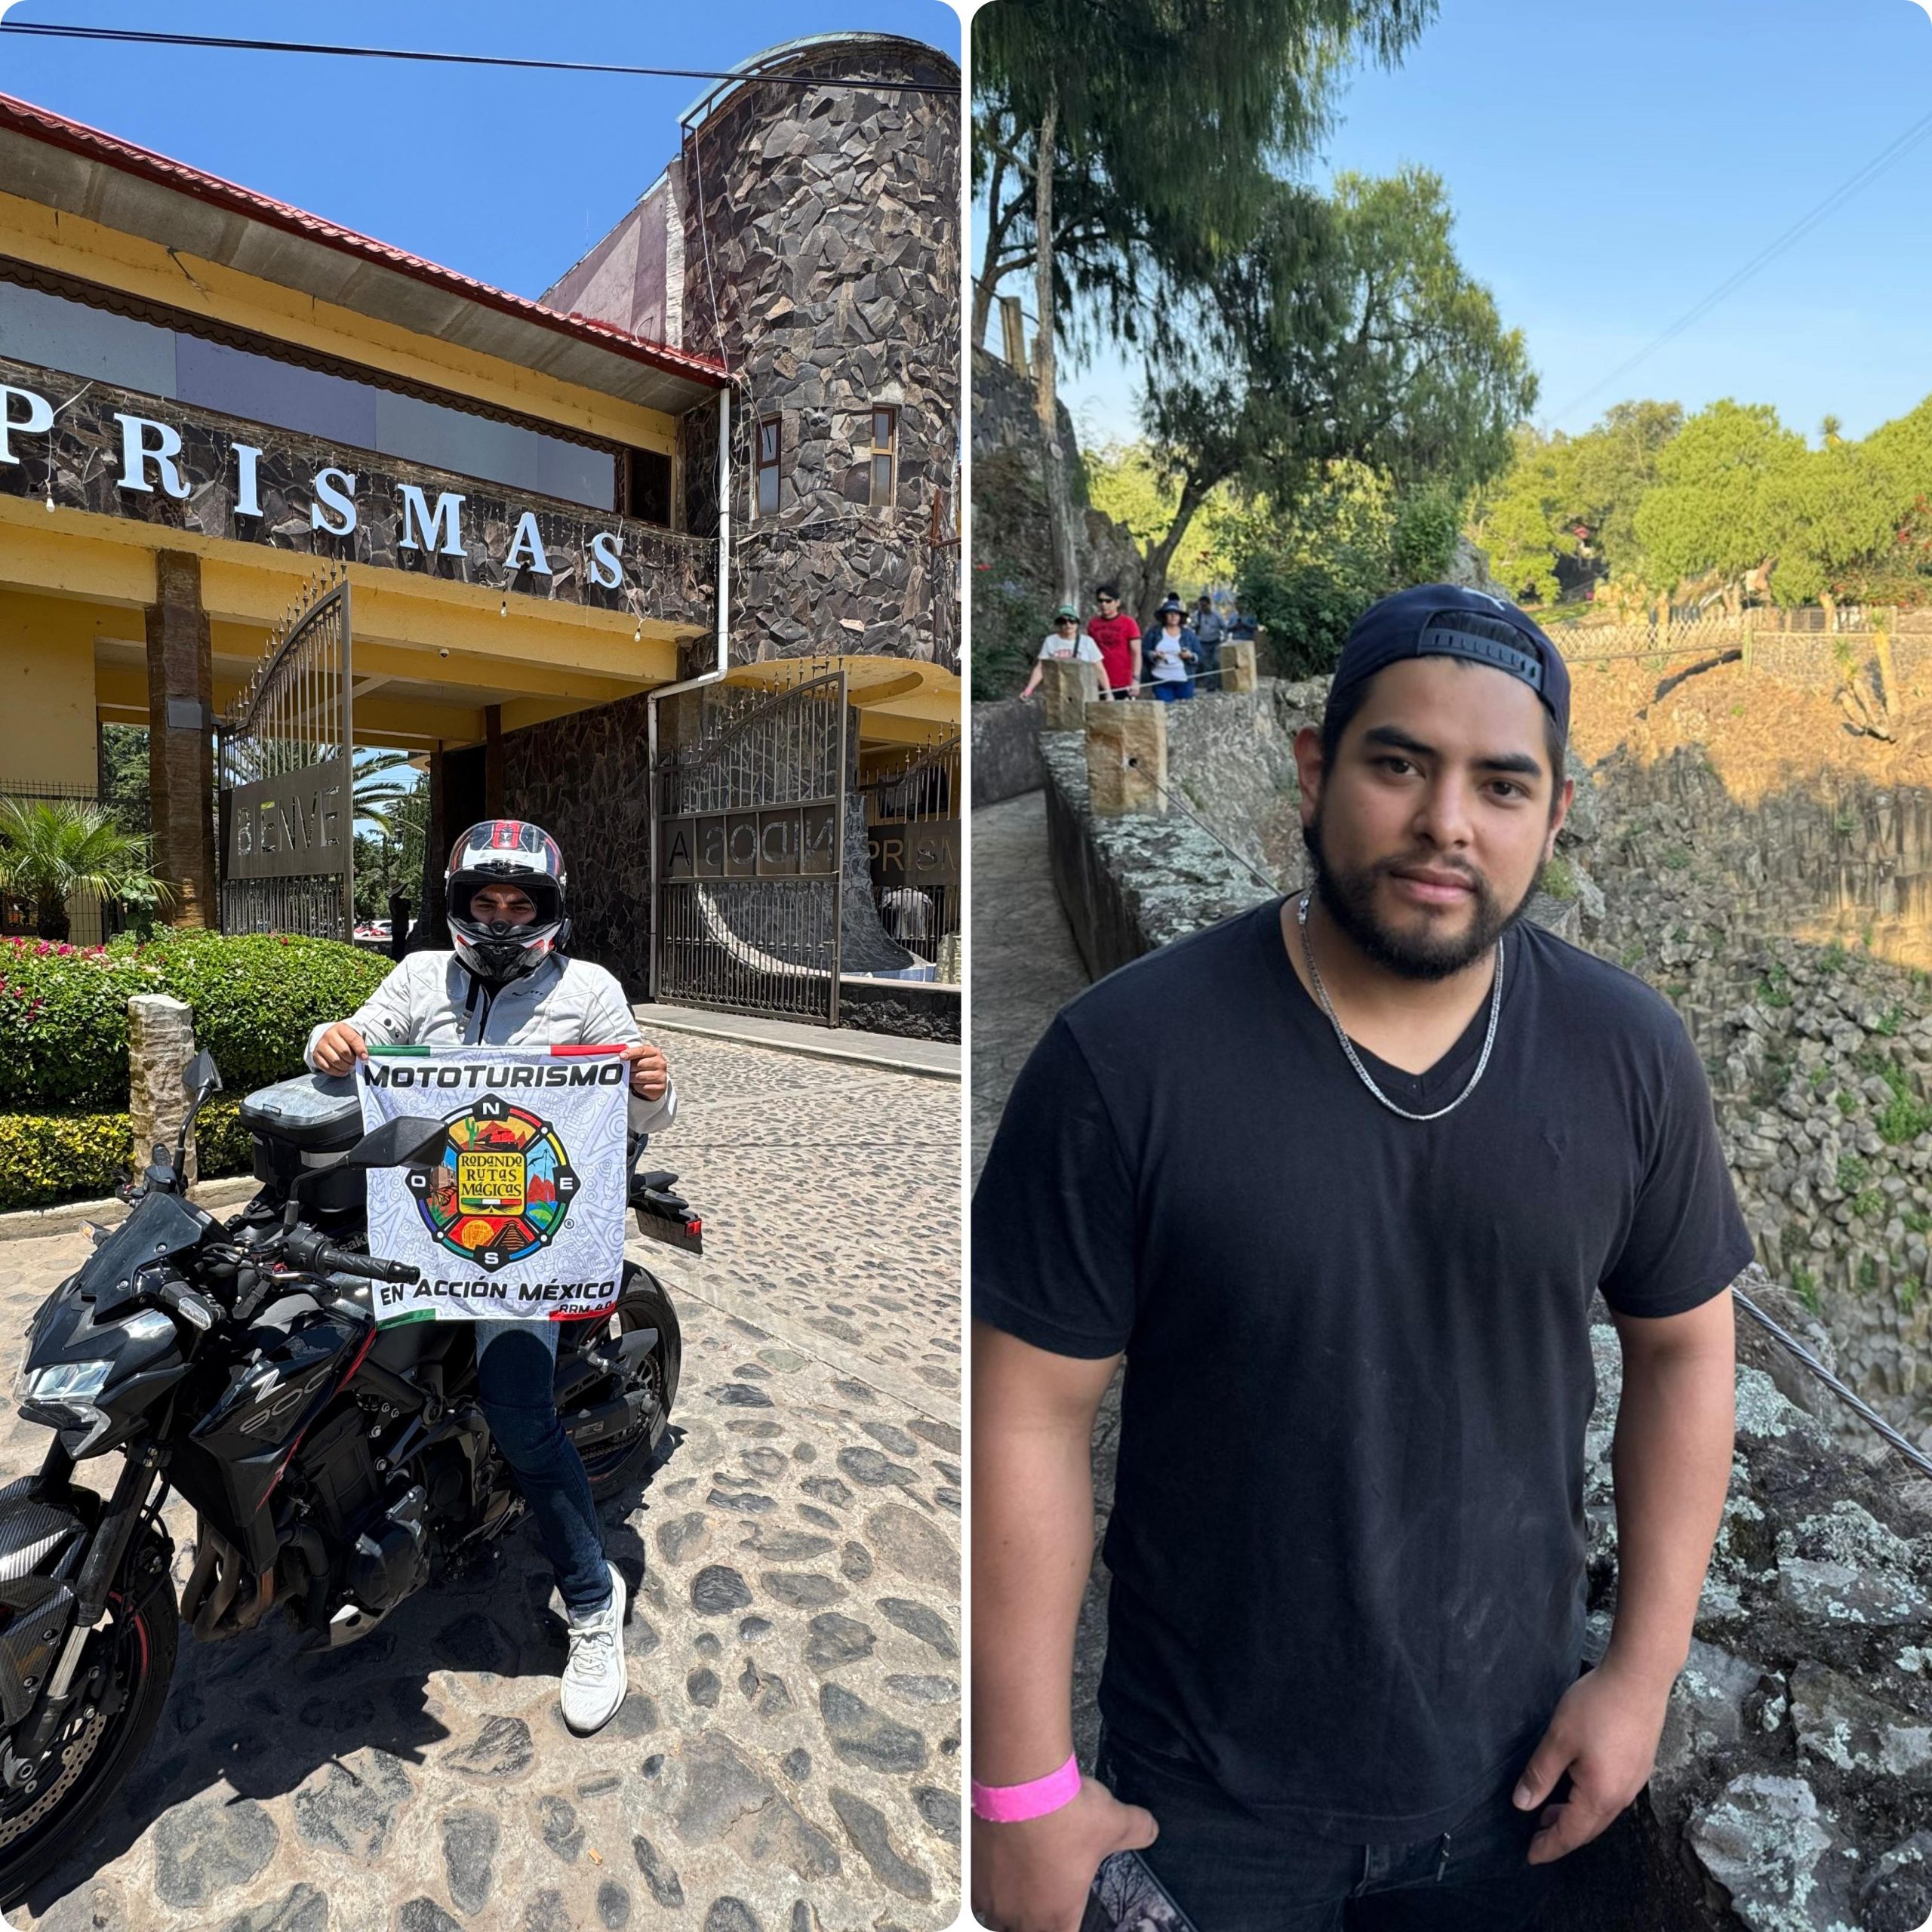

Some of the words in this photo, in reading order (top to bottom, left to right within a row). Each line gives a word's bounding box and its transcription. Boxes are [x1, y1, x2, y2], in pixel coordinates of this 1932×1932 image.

[0, 383, 624, 589] PRISMAS
[482, 1102, 500, 1115] N
[559, 1177, 574, 1190] E
[484, 1251, 499, 1265] S
[380, 1284, 405, 1306] EN
[413, 1275, 508, 1299] ACCIÓN
[518, 1278, 615, 1302] MÉXICO
[558, 1303, 591, 1314] RRM
[251, 1367, 287, 1404] Z
